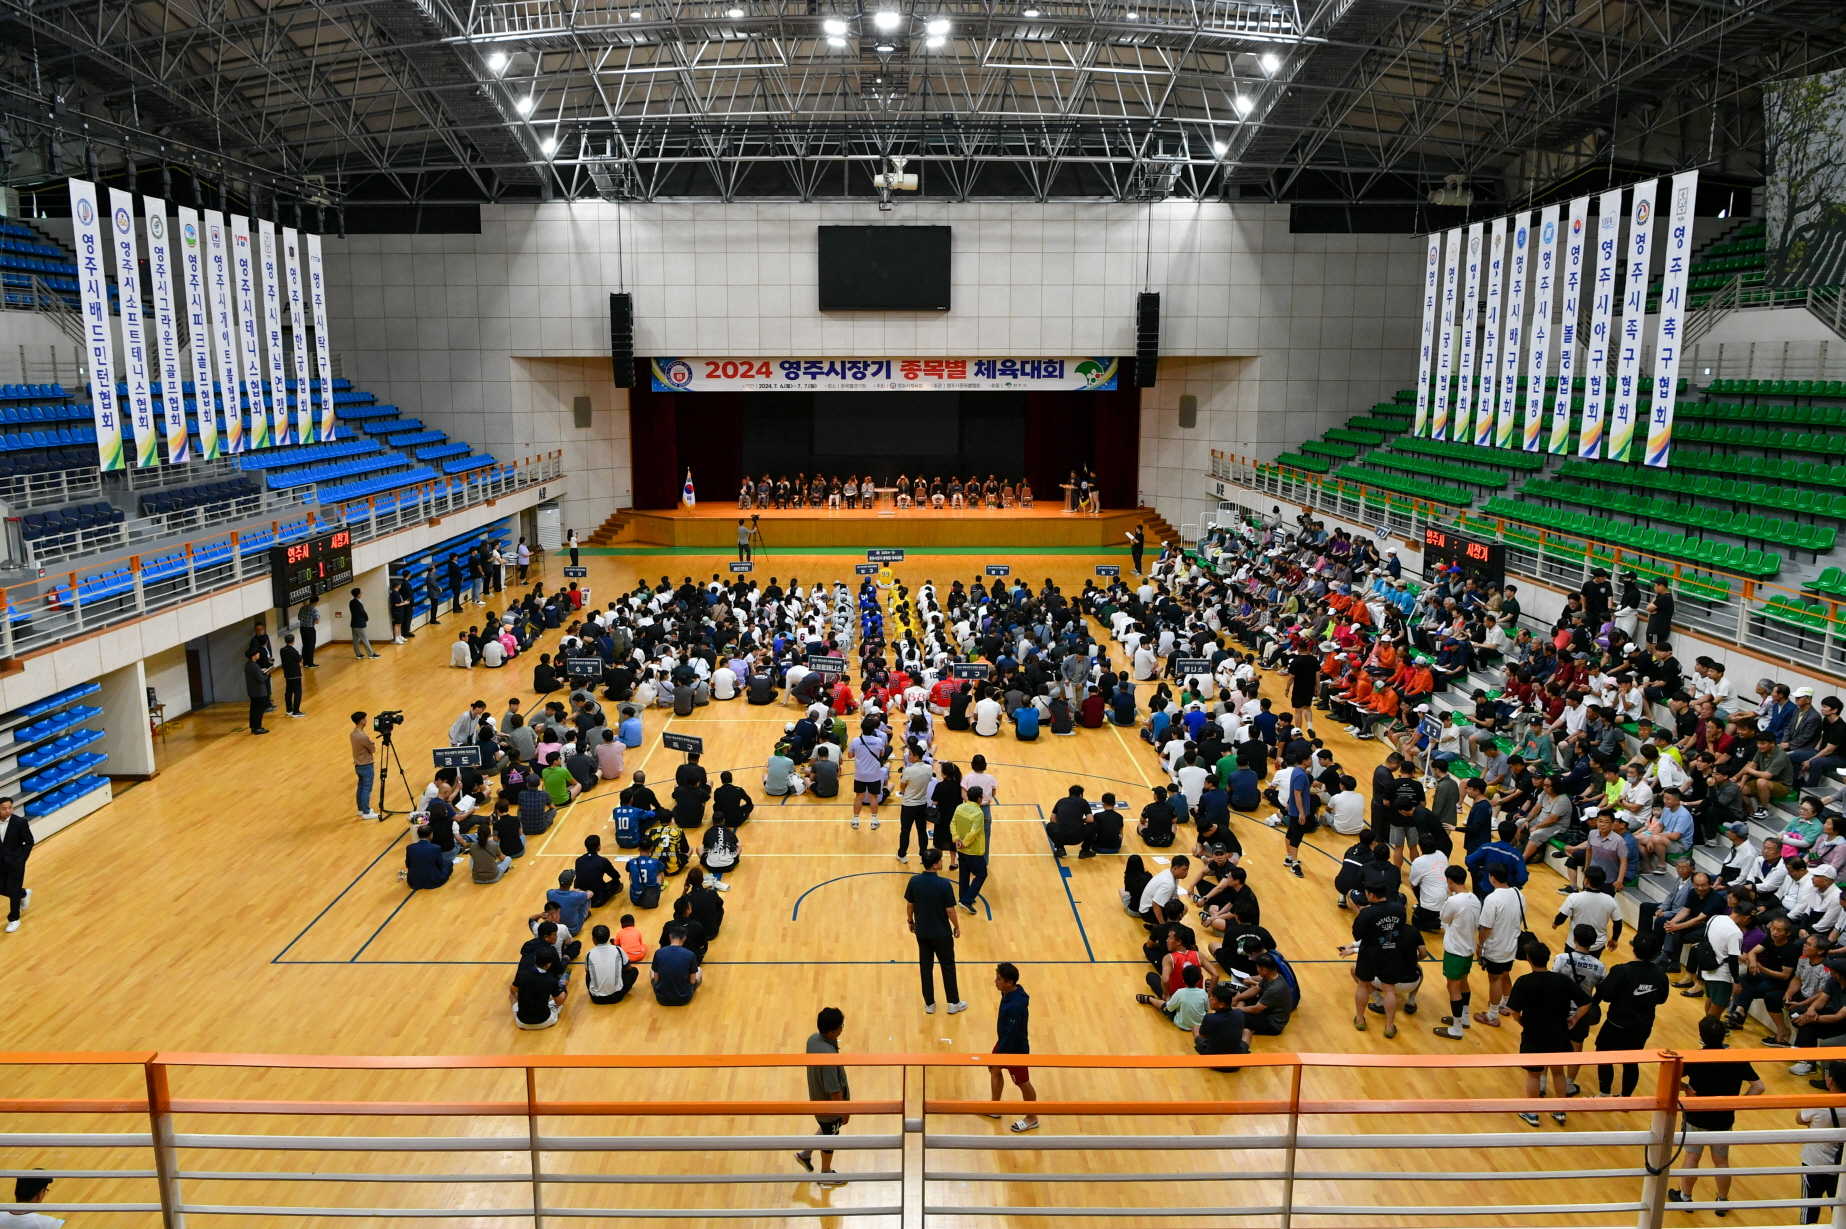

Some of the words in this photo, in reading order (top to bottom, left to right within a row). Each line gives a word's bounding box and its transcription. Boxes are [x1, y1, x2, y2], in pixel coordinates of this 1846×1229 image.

[82, 233, 115, 431] 영주시배드민턴협회
[120, 241, 150, 430] 영주시소프트테니스협회
[154, 246, 181, 427] 영주시그라운드골프협회
[239, 257, 262, 416] 영주시테니스협회
[289, 267, 309, 414] 영주시한궁협회
[313, 272, 331, 412] 영주시탁구협회
[704, 360, 773, 379] 2024
[779, 360, 892, 381] 영주시장기
[900, 360, 967, 380] 종목별
[974, 359, 1065, 380] 체육대회
[1419, 271, 1436, 410] 영주시체육회
[1437, 267, 1455, 412] 영주시궁도협회
[1459, 263, 1477, 413] 영주시골프협회
[1503, 255, 1524, 416] 영주시배구협회
[1531, 250, 1552, 418] 영주시수영연맹
[1556, 244, 1581, 420] 영주시볼링협회
[1587, 239, 1614, 423] 영주시야구협회
[1617, 233, 1647, 424] 영주시족구협회
[1654, 226, 1687, 428] 영주시축구협회
[287, 543, 310, 564] 영주시
[330, 531, 350, 549] 시장기
[318, 562, 325, 577] 1
[1426, 529, 1447, 548] 영주시
[1466, 542, 1489, 562] 시장기
[799, 633, 806, 641] 6
[811, 663, 842, 672] 소프트테니스
[907, 692, 925, 702] 88
[618, 816, 629, 830] 10
[659, 834, 670, 848] 3
[1375, 915, 1400, 927] MONSTER
[1381, 922, 1396, 931] SURF
